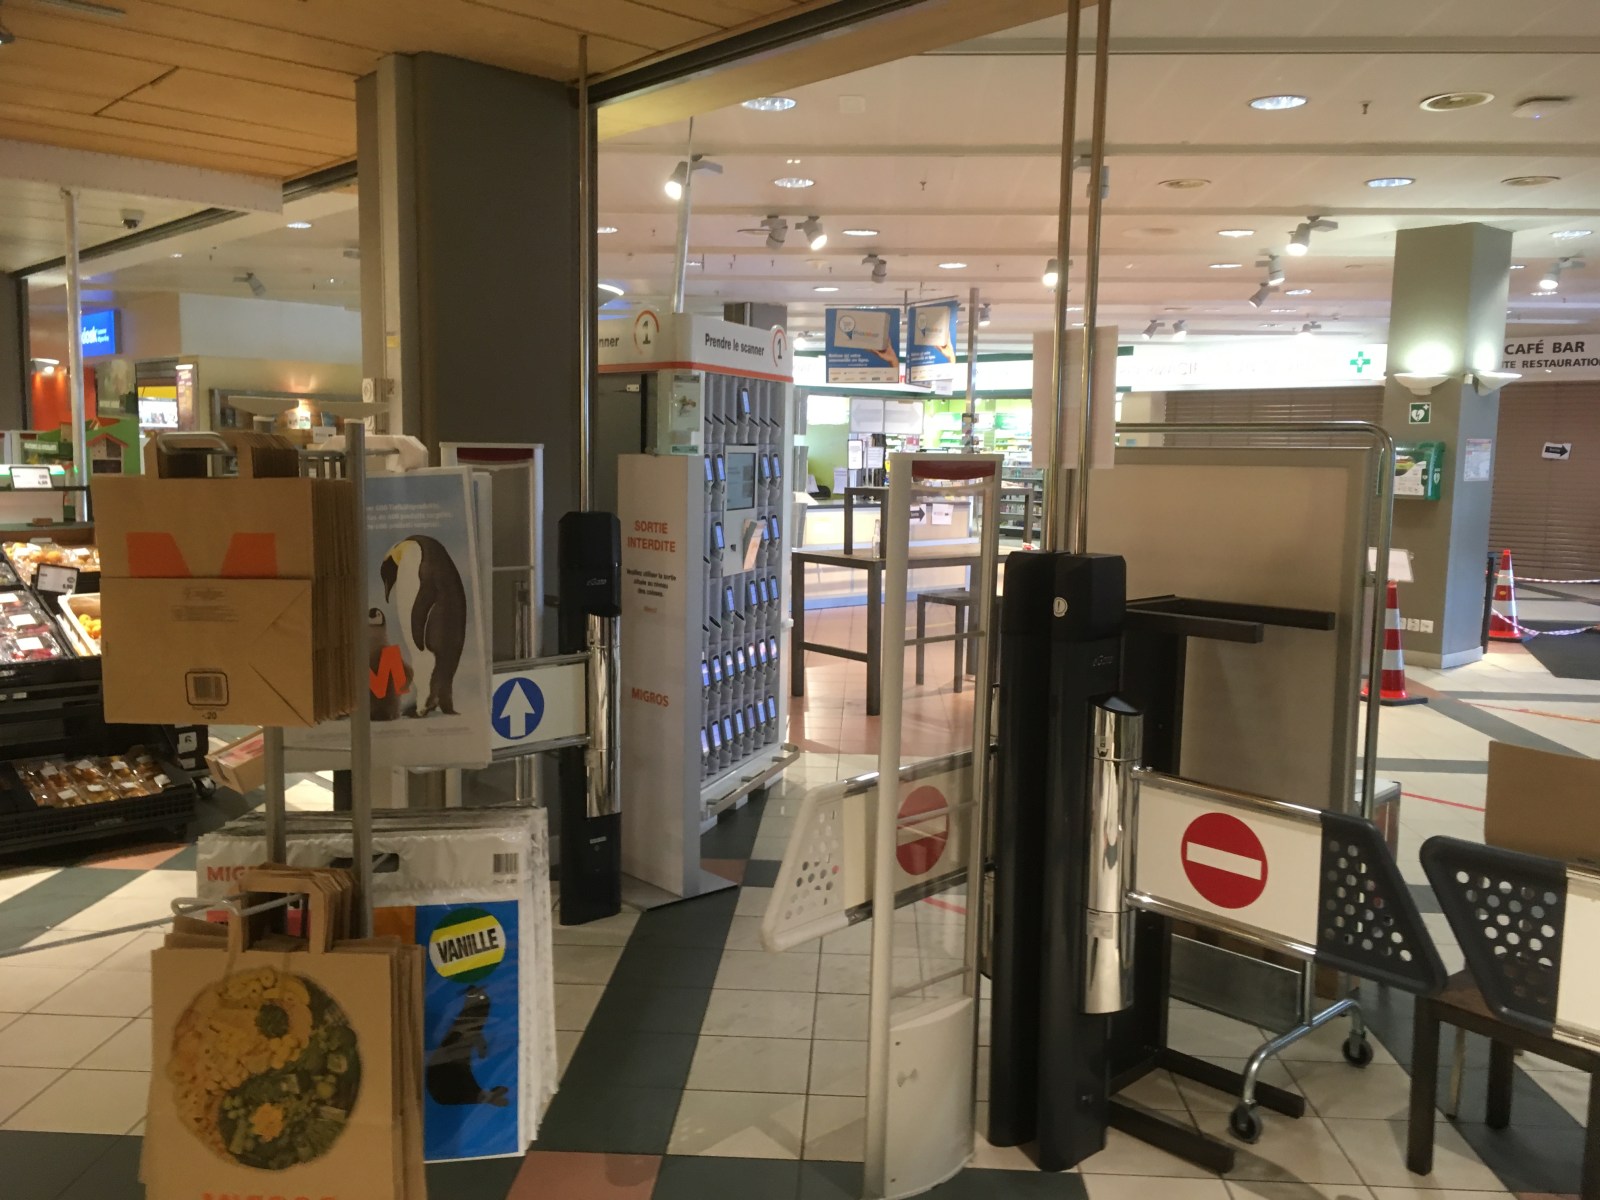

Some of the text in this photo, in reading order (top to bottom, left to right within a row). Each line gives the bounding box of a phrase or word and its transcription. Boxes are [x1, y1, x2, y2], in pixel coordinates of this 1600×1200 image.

[598, 337, 620, 348] nner
[704, 332, 765, 356] Prendre le scanner
[777, 338, 783, 360] 1
[1504, 339, 1585, 355] CAFÉ BAR
[1502, 357, 1600, 369] ITE RESTAURATIO
[634, 520, 668, 535] SORTIE
[627, 536, 676, 553] INTERDITE
[631, 687, 669, 707] MIGROS
[207, 866, 245, 882] MIG
[436, 928, 500, 963] VANILLE
